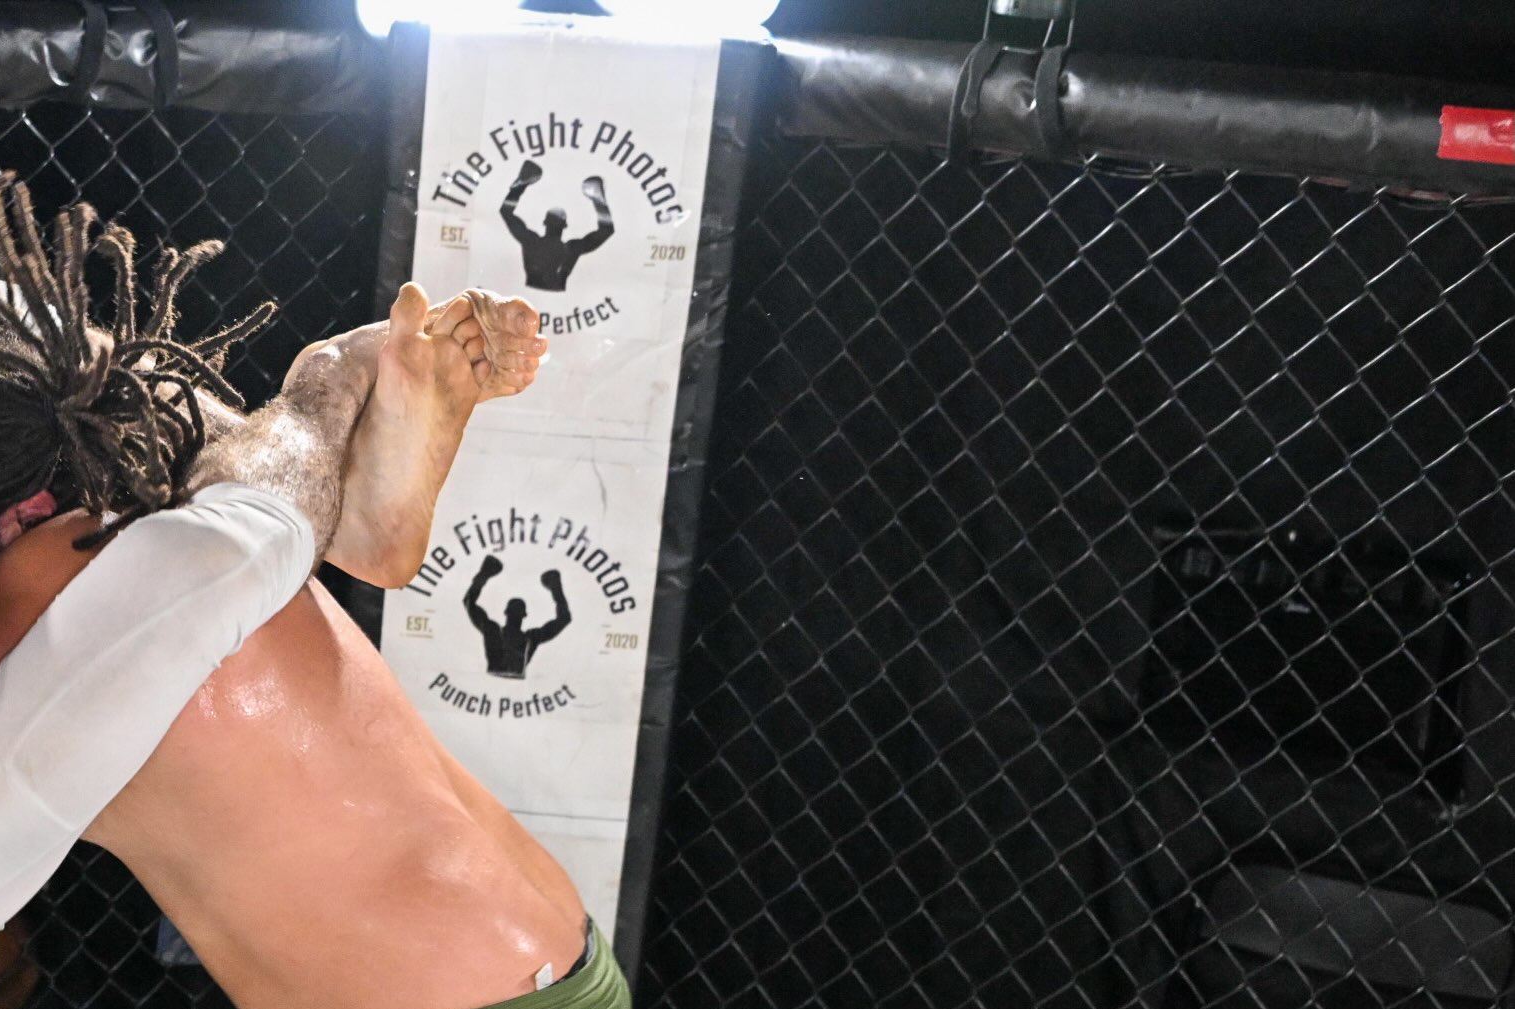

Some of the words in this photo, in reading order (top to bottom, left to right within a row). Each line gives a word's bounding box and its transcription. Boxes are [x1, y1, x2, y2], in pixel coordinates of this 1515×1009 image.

[432, 151, 493, 208] The
[489, 112, 583, 161] Fight
[590, 121, 685, 224] Photos
[440, 224, 468, 244] EST.
[650, 244, 686, 261] 2020
[538, 296, 620, 334] Perfect
[454, 507, 541, 556] Fight
[547, 516, 636, 614] Photos
[405, 616, 433, 633] EST.
[604, 633, 638, 649] 2020
[428, 672, 491, 717] Punch
[498, 684, 576, 718] Perfect
